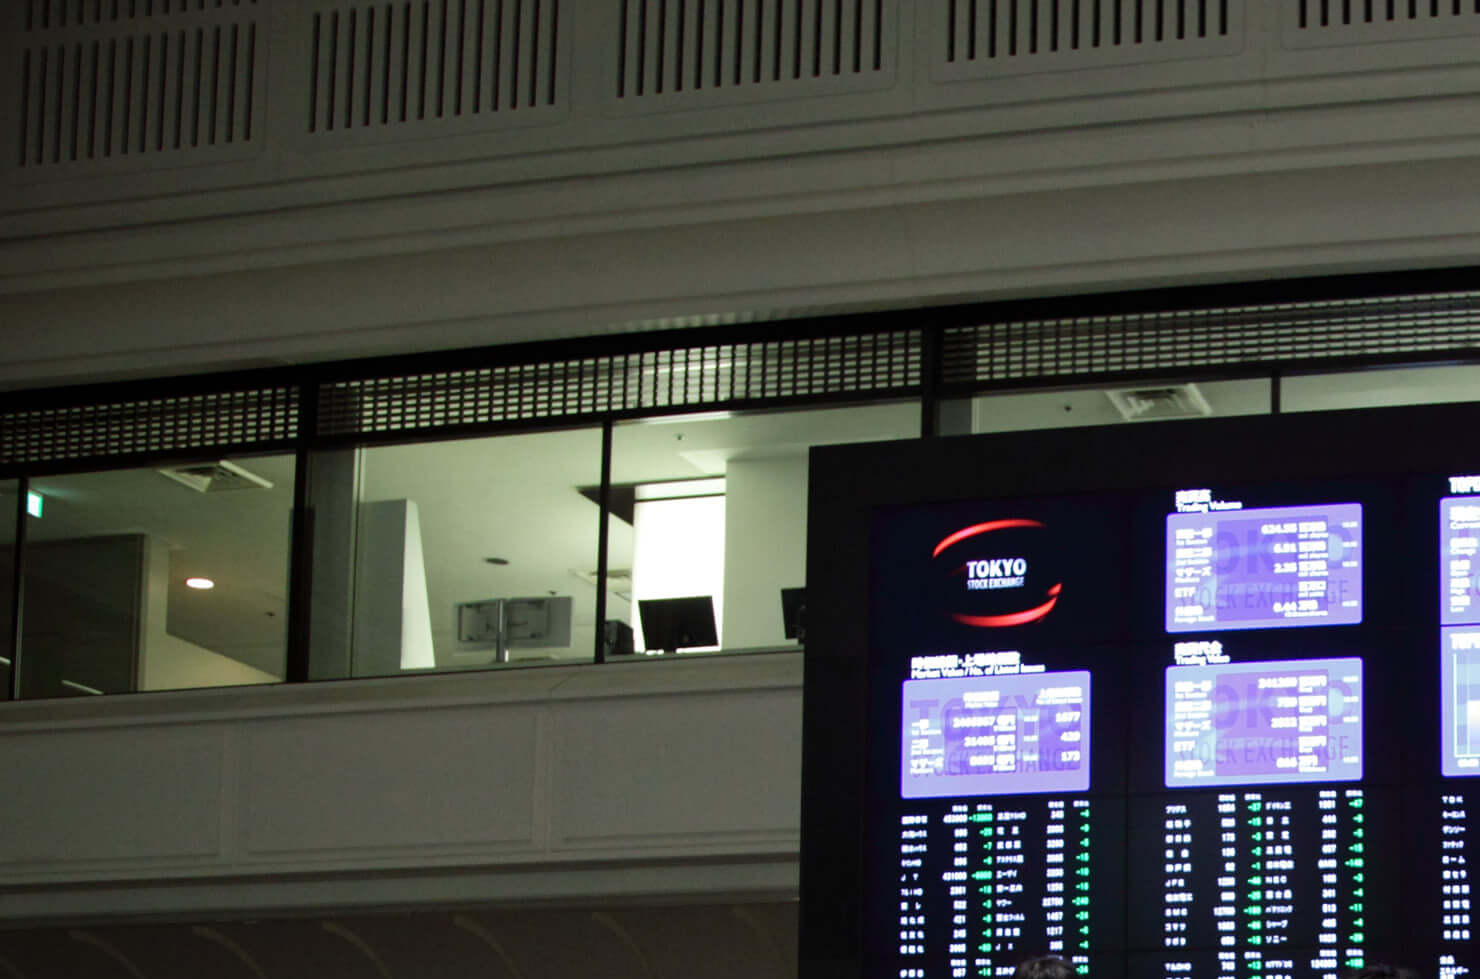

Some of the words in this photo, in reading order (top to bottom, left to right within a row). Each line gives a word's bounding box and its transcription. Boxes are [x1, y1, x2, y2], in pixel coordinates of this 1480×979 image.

[967, 558, 1027, 580] TOKYO
[968, 578, 988, 590] STOCK
[988, 576, 1025, 589] EXCHANGE
